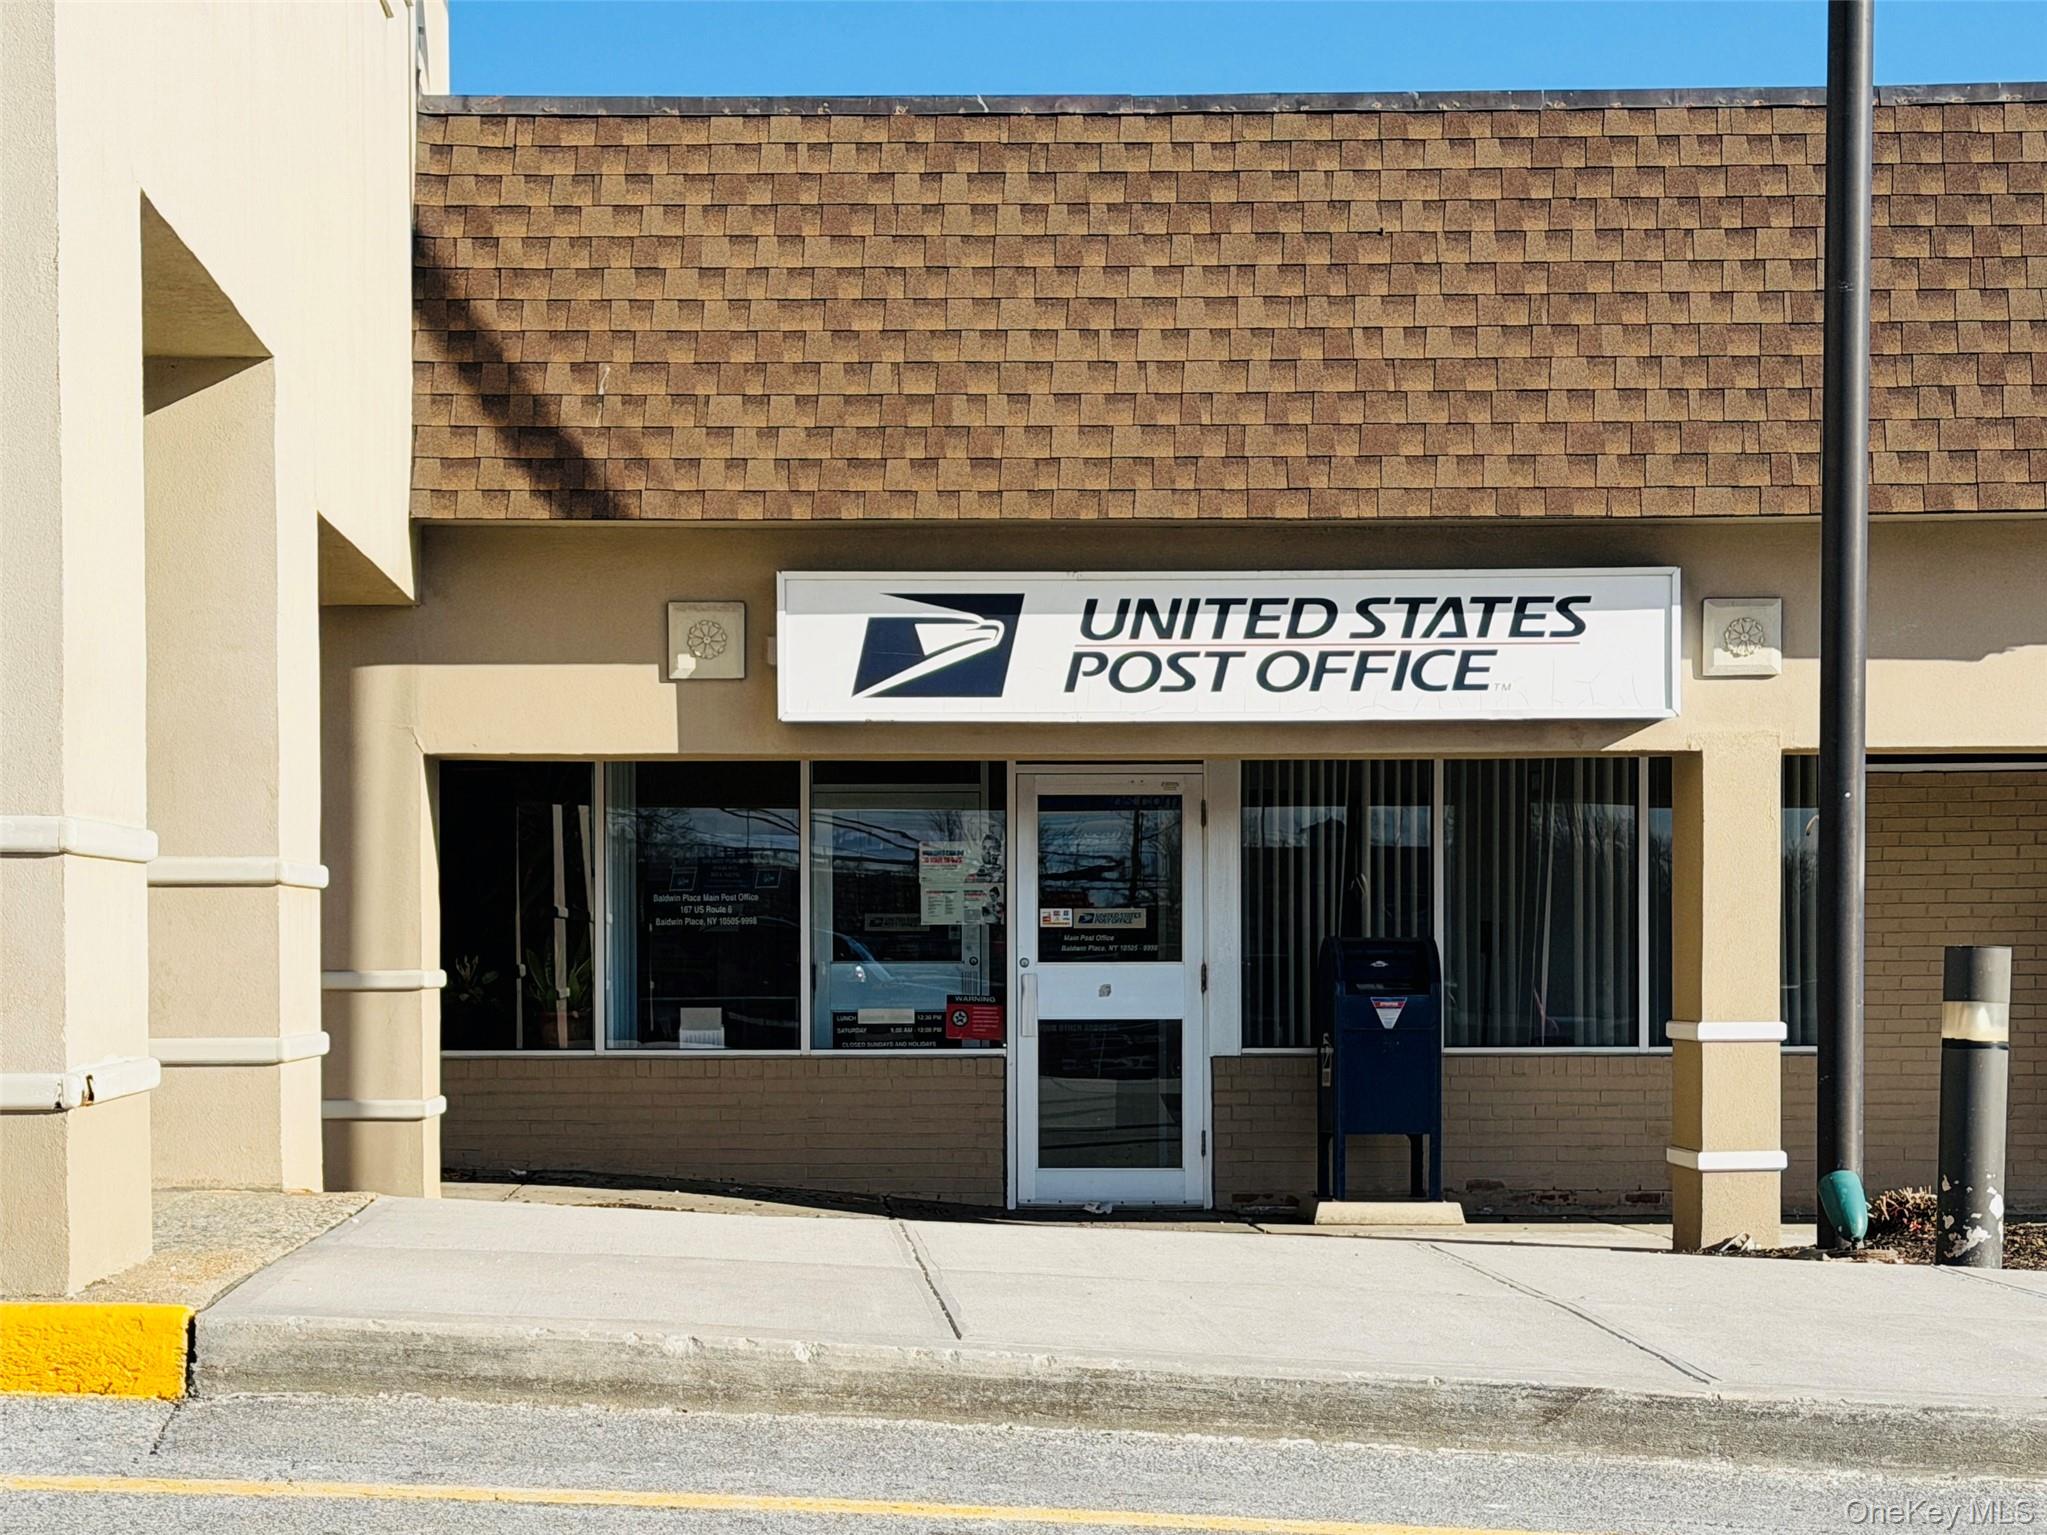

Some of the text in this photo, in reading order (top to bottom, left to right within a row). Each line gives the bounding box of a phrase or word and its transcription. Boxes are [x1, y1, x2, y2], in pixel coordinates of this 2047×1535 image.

[1080, 595, 1592, 640] UNITED STATES
[1064, 649, 1498, 695] POST OFFICE
[653, 893, 759, 902] Baldwin Place Main Post Office
[694, 905, 705, 913] US
[706, 905, 726, 913] Route
[655, 917, 683, 926] Baldwin
[707, 917, 718, 925] NY
